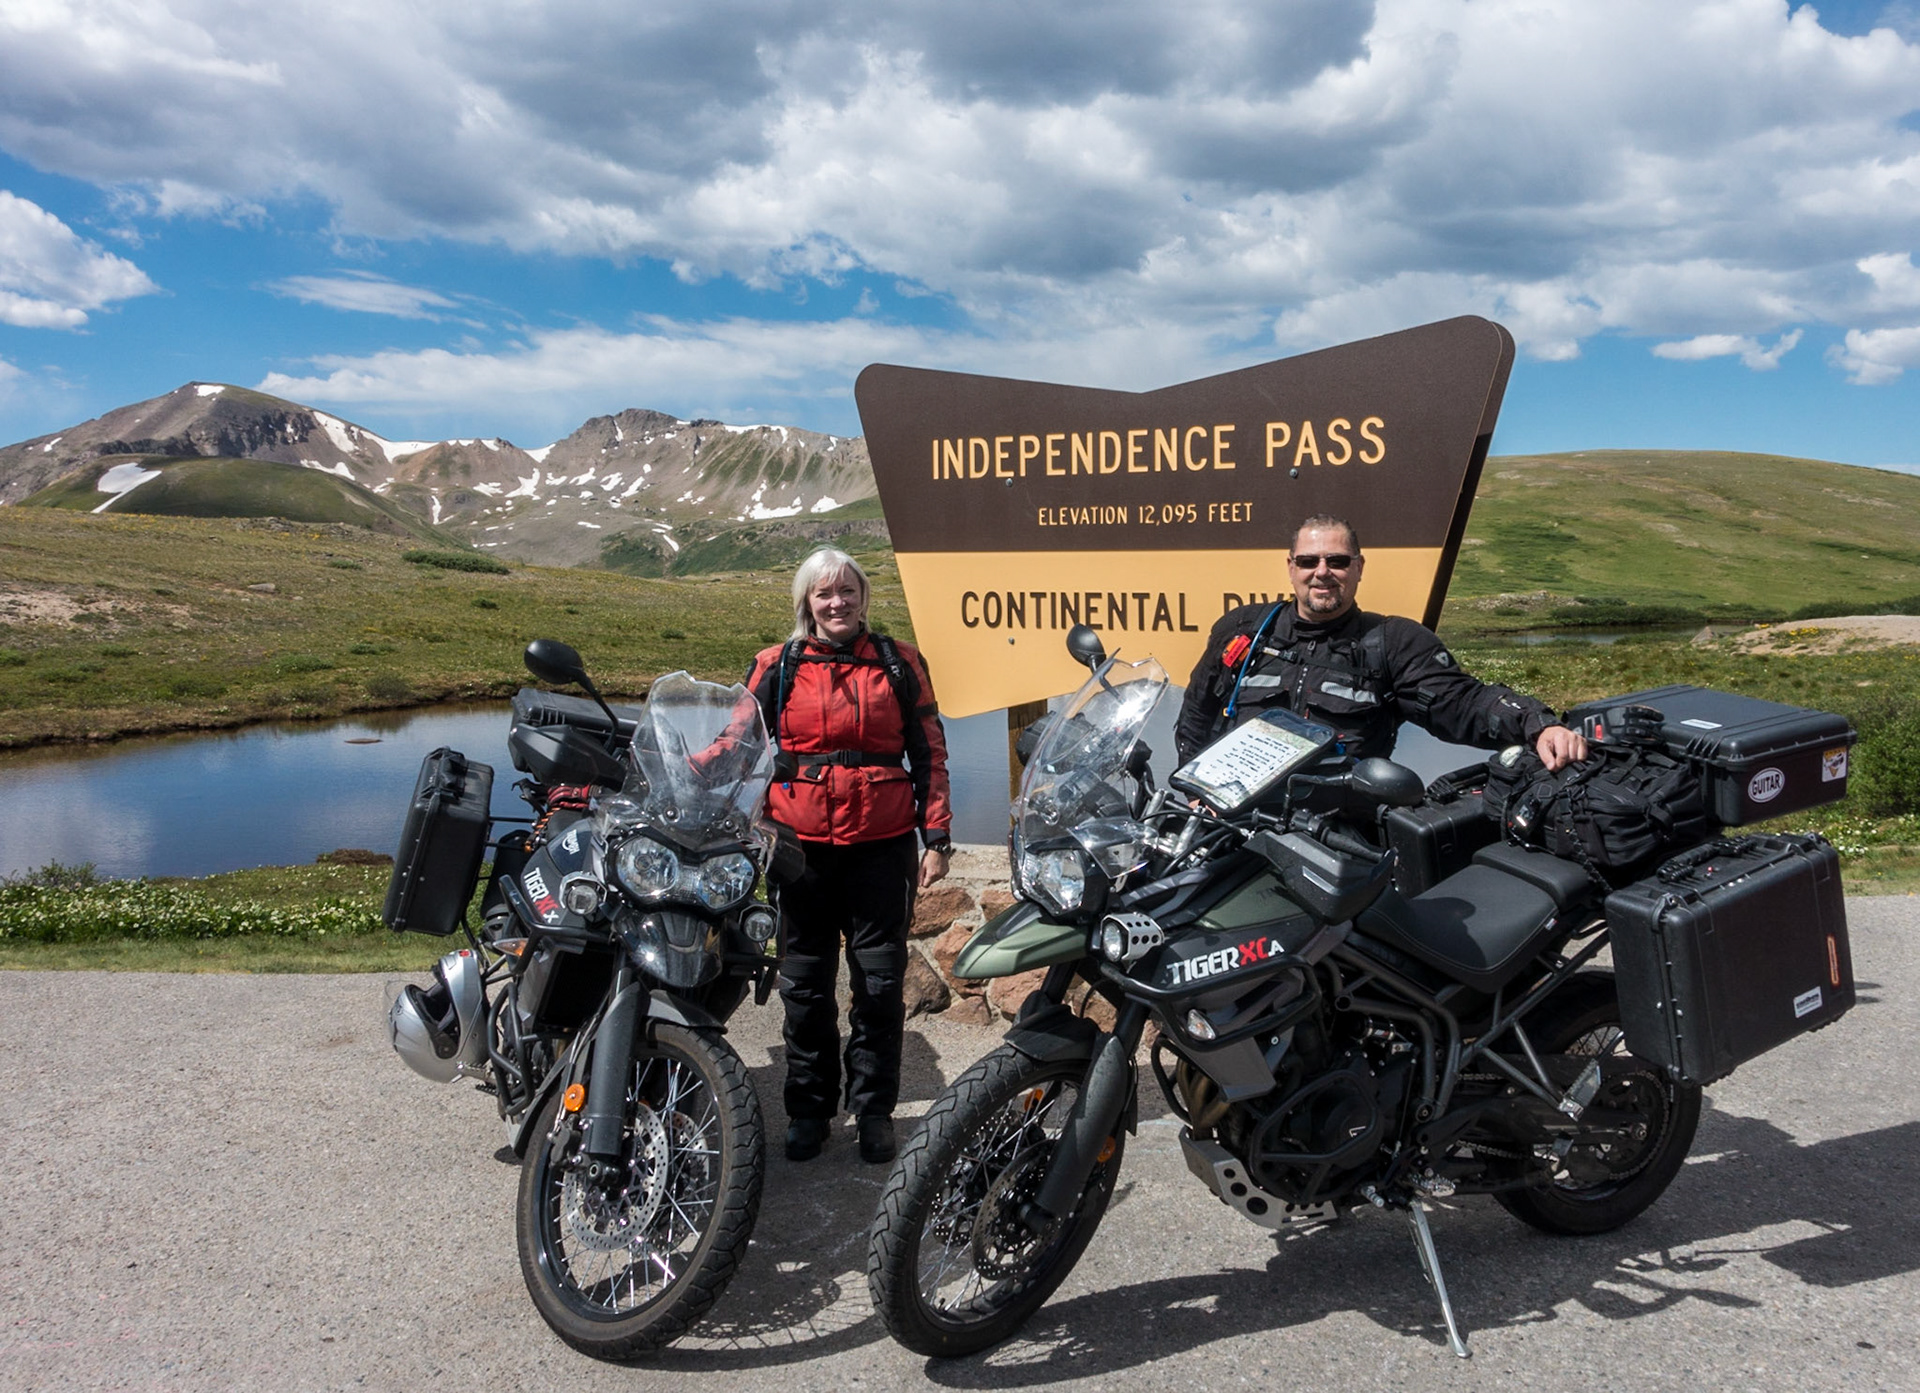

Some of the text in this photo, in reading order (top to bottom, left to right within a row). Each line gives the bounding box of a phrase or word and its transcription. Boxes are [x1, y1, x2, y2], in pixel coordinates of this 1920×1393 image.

[932, 416, 1386, 480] INDEPENDENCE PASS
[1038, 502, 1253, 527] ELEVATION 12,095 FEET
[961, 590, 1199, 632] CONTINENTAL
[1752, 774, 1780, 796] GUITAR
